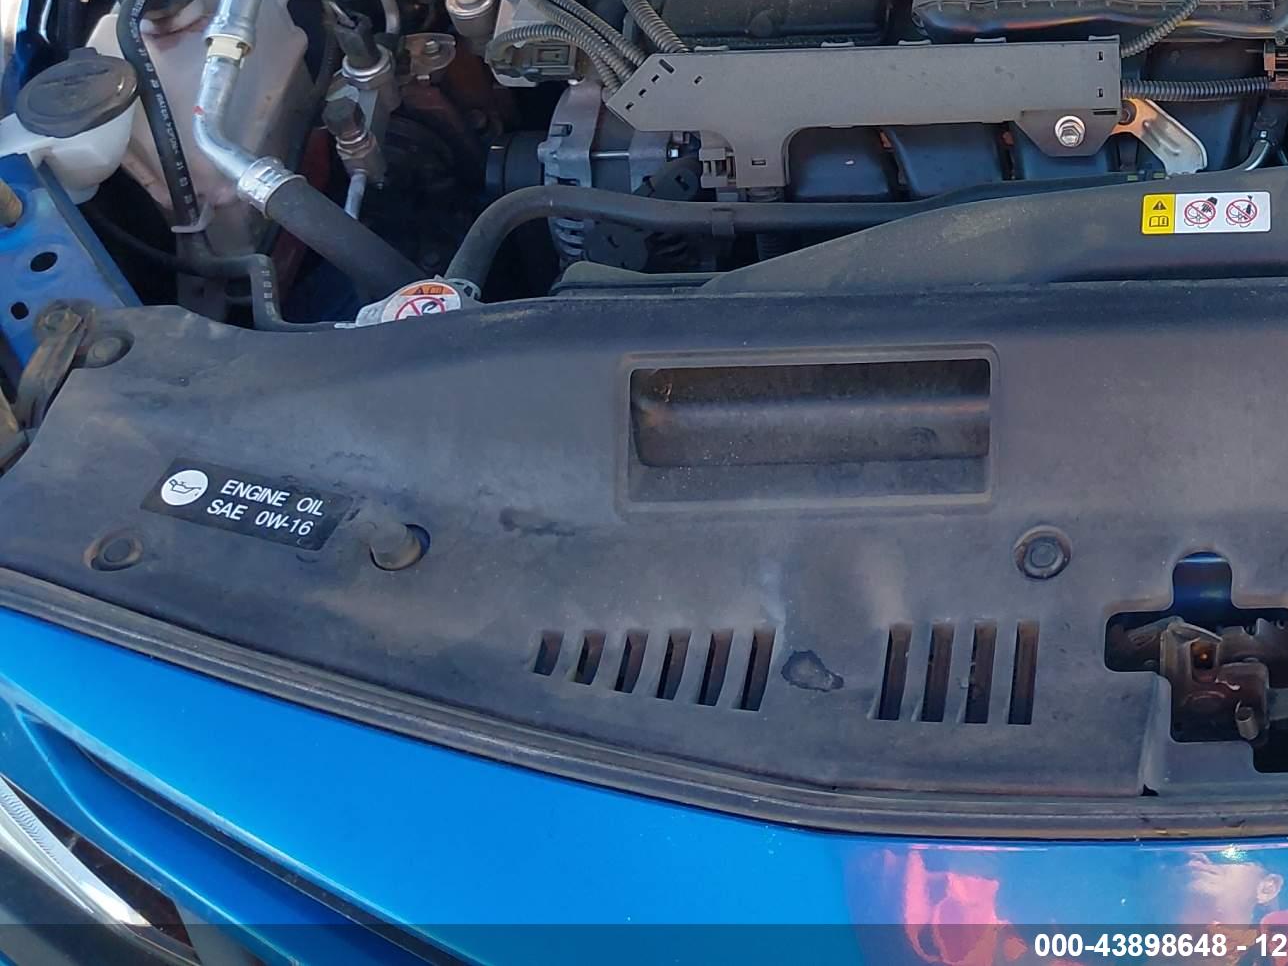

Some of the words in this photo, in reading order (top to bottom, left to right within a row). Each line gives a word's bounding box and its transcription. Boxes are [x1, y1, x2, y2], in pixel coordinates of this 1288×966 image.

[206, 498, 249, 520] SAE
[220, 479, 290, 507] ENGINE
[296, 497, 324, 516] OIL
